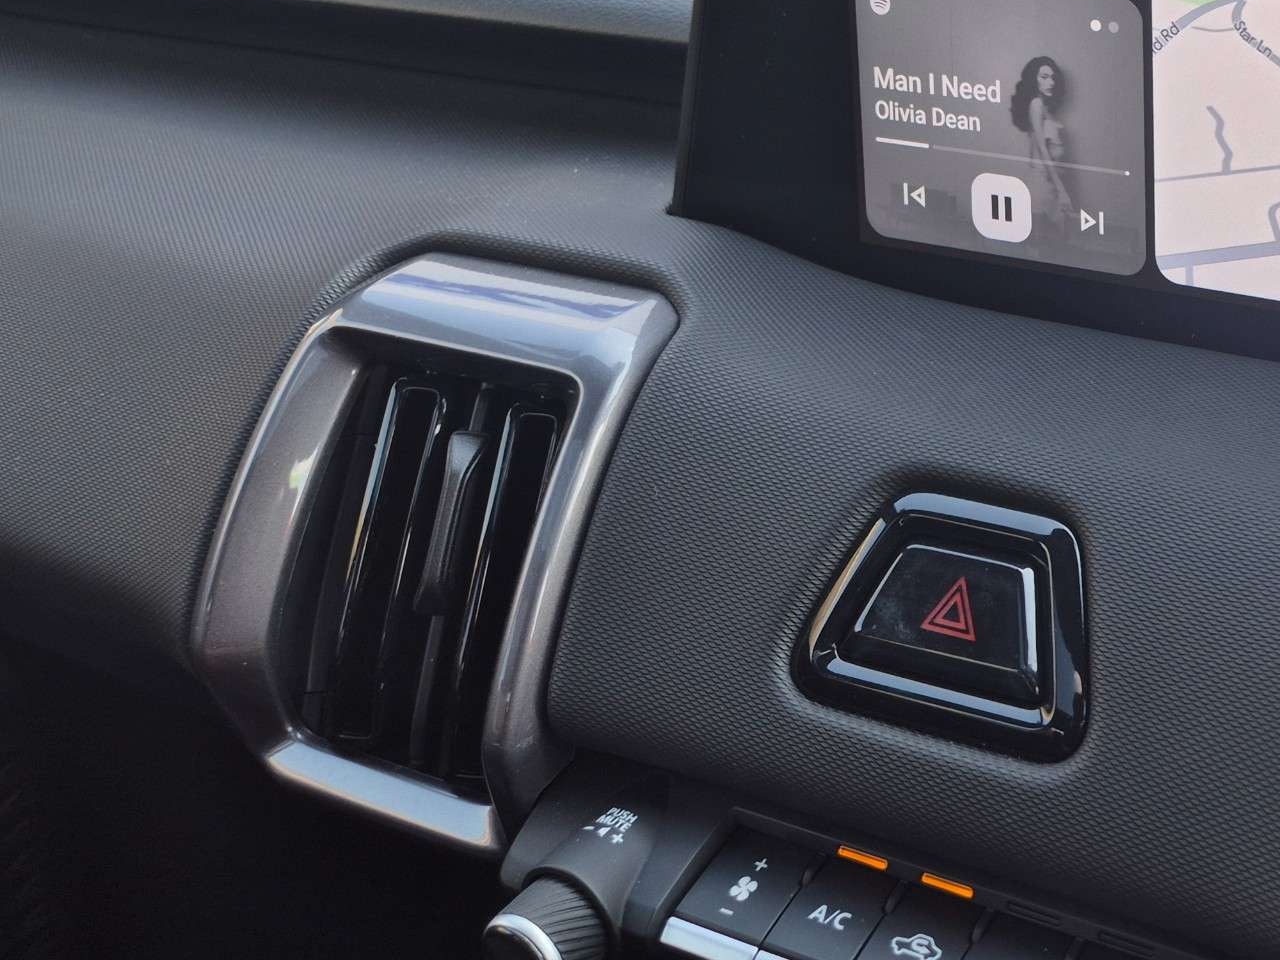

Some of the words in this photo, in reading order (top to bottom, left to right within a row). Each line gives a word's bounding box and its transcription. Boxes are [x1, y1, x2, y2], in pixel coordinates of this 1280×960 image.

[1160, 21, 1181, 43] Rd
[1233, 20, 1256, 46] Star
[1255, 39, 1273, 58] Ln
[872, 66, 922, 94] Man
[928, 73, 935, 95] I
[941, 74, 1001, 103] Need
[875, 100, 927, 125] Olivia
[932, 107, 981, 132] Dean
[595, 814, 632, 832] MUTE
[606, 807, 638, 823] PUSH
[807, 903, 853, 931] A/C
